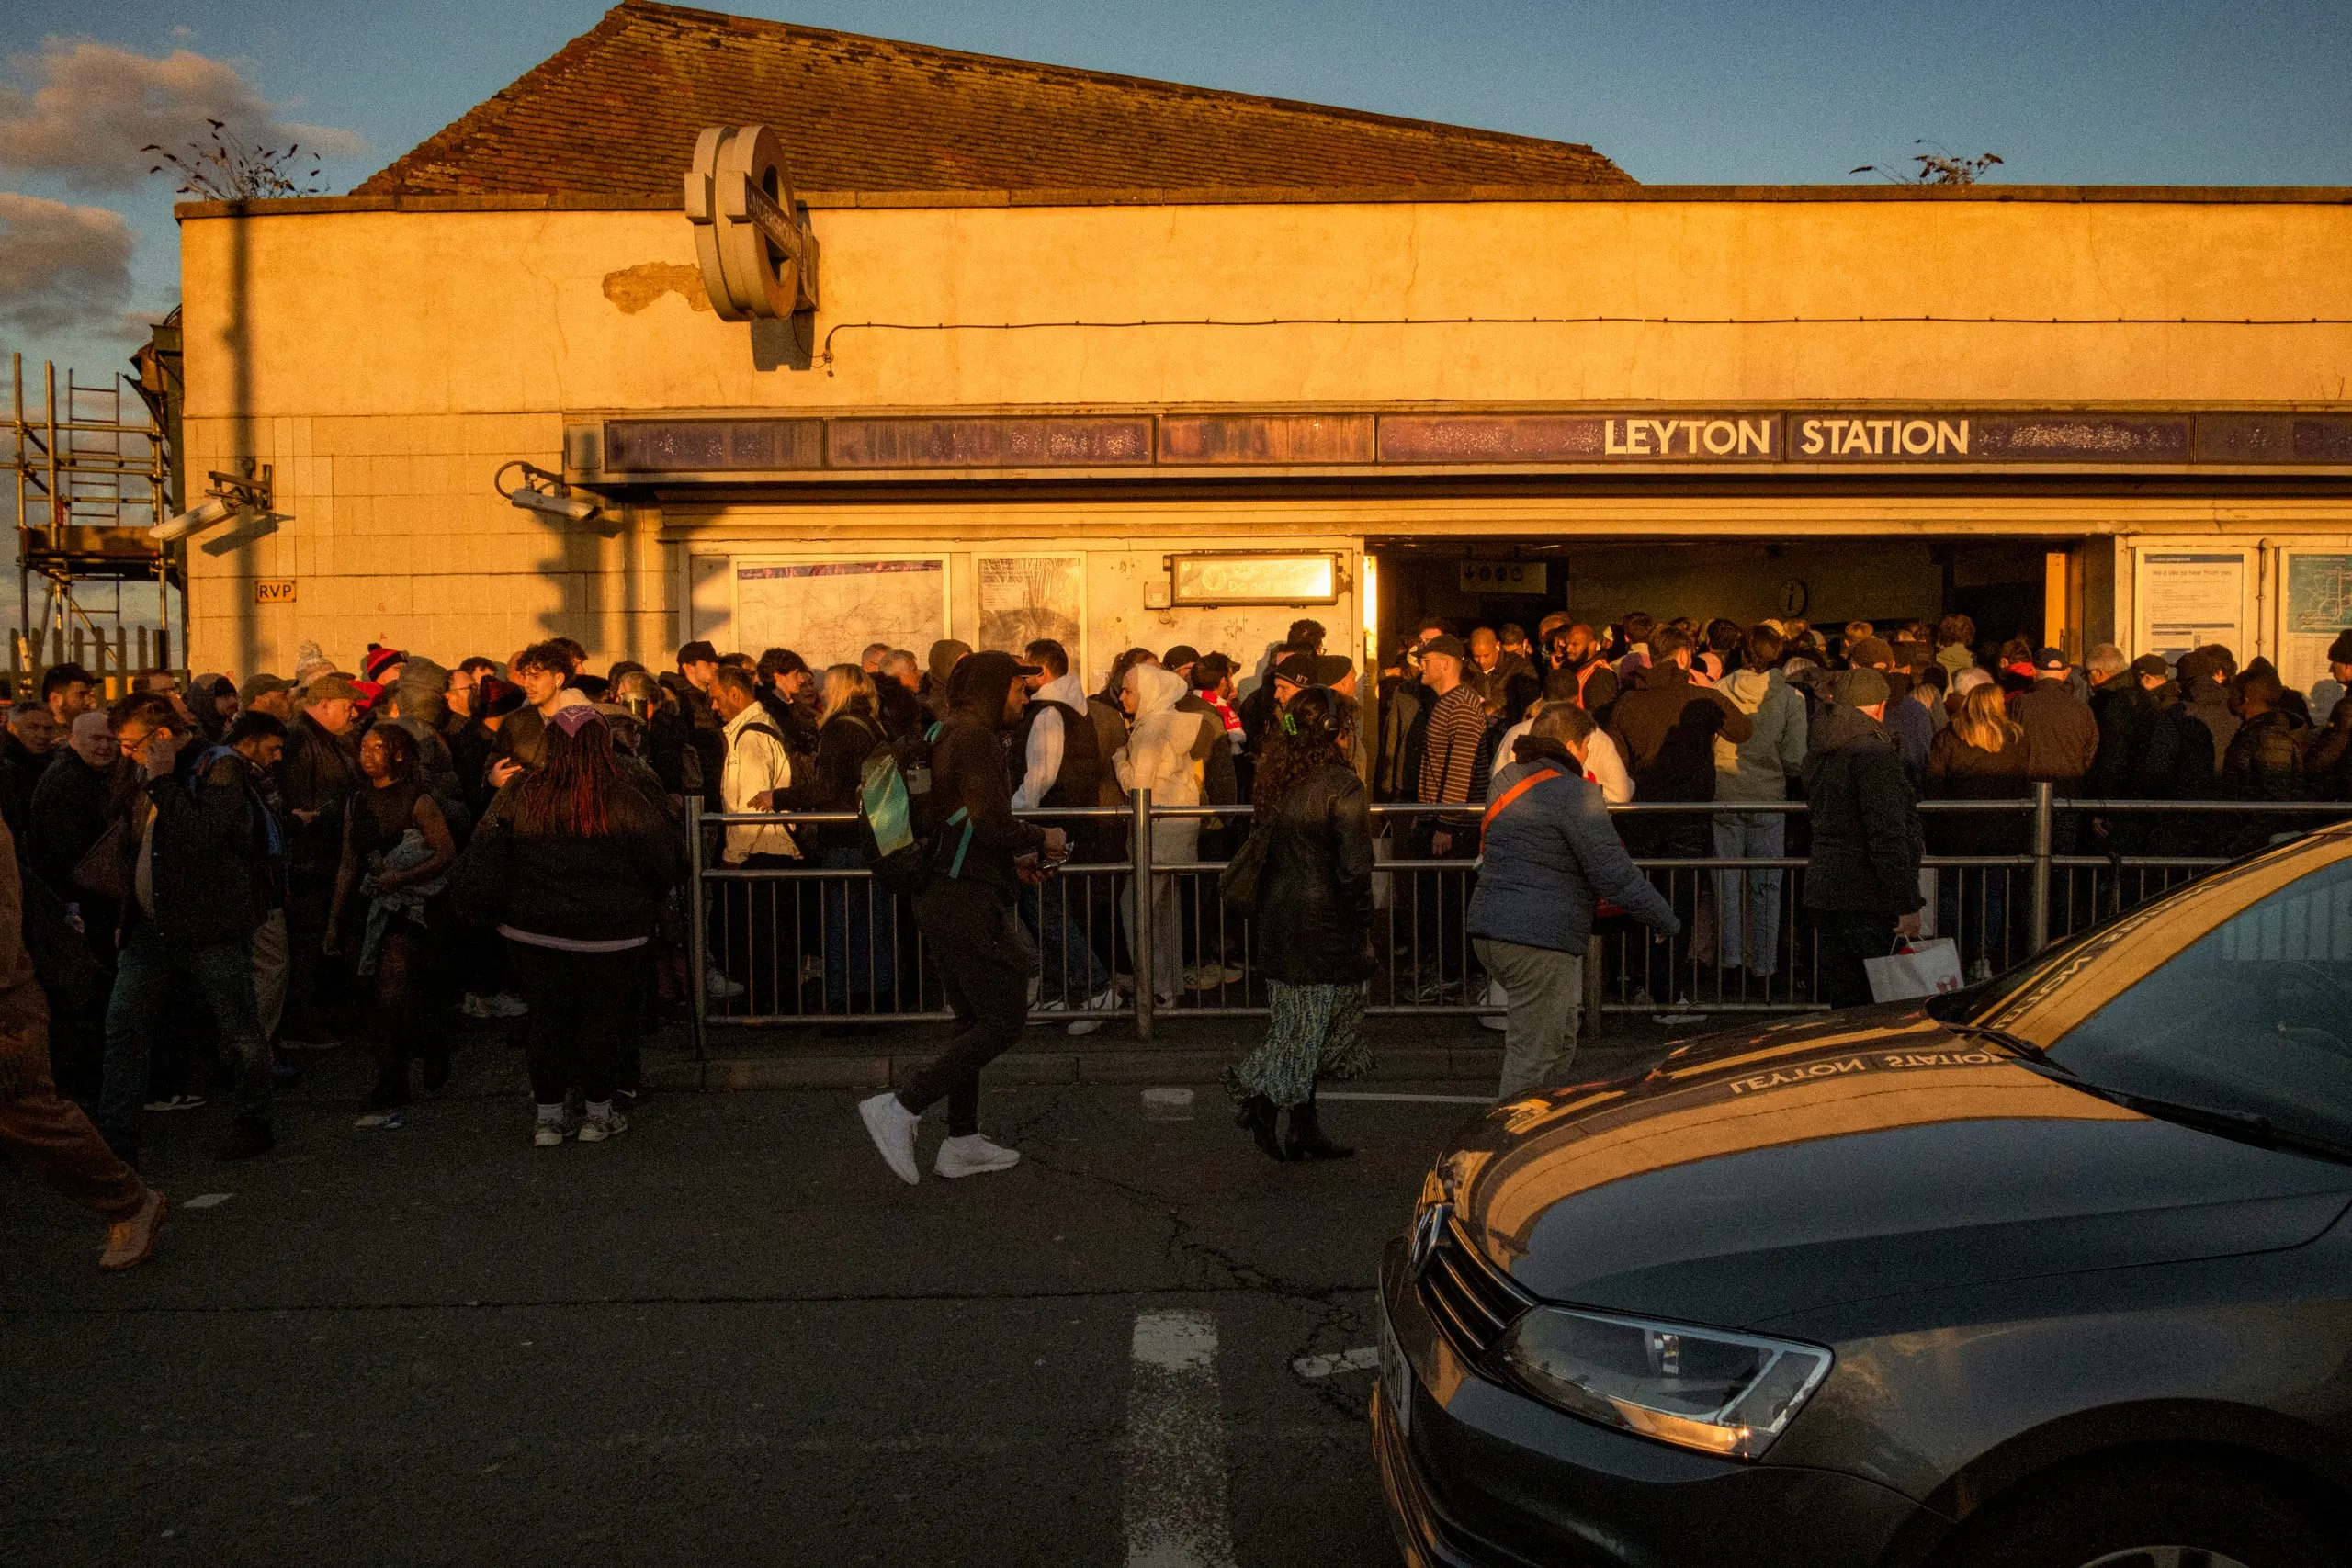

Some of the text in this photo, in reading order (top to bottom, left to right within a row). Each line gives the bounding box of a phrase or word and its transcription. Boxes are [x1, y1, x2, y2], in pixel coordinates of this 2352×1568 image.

[1604, 419, 1969, 456] LEYTON STATION
[258, 584, 292, 598] RVP
